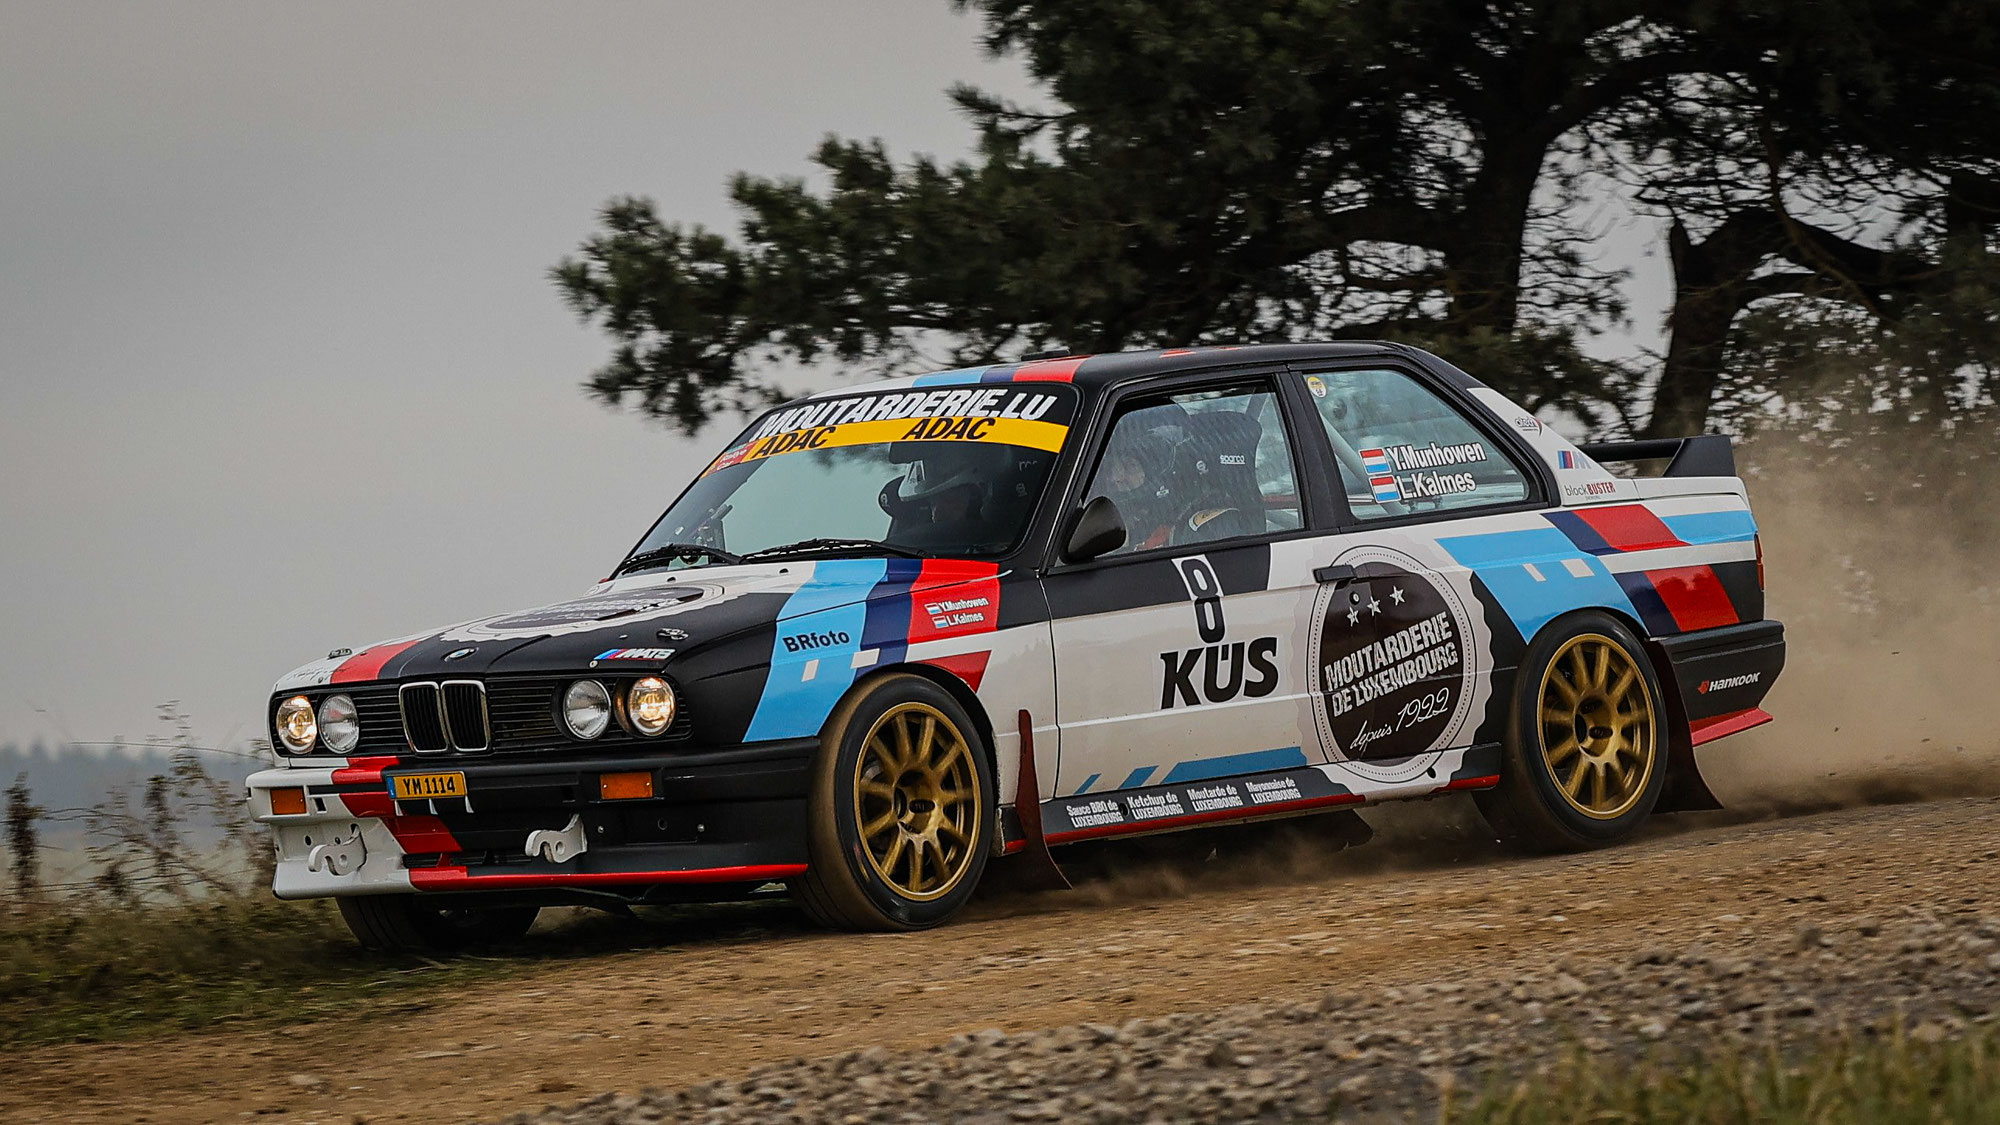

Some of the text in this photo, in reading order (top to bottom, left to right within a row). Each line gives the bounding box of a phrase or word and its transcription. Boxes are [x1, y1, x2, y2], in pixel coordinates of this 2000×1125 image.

[749, 389, 1057, 442] MOUTARDERIE.LU
[901, 417, 996, 440] ADAC
[752, 426, 836, 459] ADAC
[1220, 454, 1245, 464] sparco
[1386, 441, 1487, 471] Y.Munhowen
[1396, 470, 1476, 500] L.Kalmes
[938, 597, 989, 612] Y.Munhowen
[1181, 558, 1226, 644] 8
[945, 612, 984, 626] L.Kalmes
[783, 629, 850, 652] BRfoto
[1324, 611, 1453, 692] MOUTARDERIE
[1160, 637, 1279, 709] KÜS
[1332, 641, 1459, 717] DE LUXEMBOURG
[1350, 687, 1450, 752] depuis 1922
[425, 776, 455, 794] 1114
[1285, 777, 1296, 788] de
[1127, 791, 1178, 809] Ketchup de
[1187, 784, 1238, 801] Moutarde de
[1251, 788, 1302, 804] LUXEMBOURG
[1066, 799, 1119, 816] Sauce BBQ de
[1131, 804, 1184, 820] LUXEMBOURG
[1192, 796, 1243, 812] LUXEMBOURG
[1071, 812, 1124, 828] LUXEMBOURG
